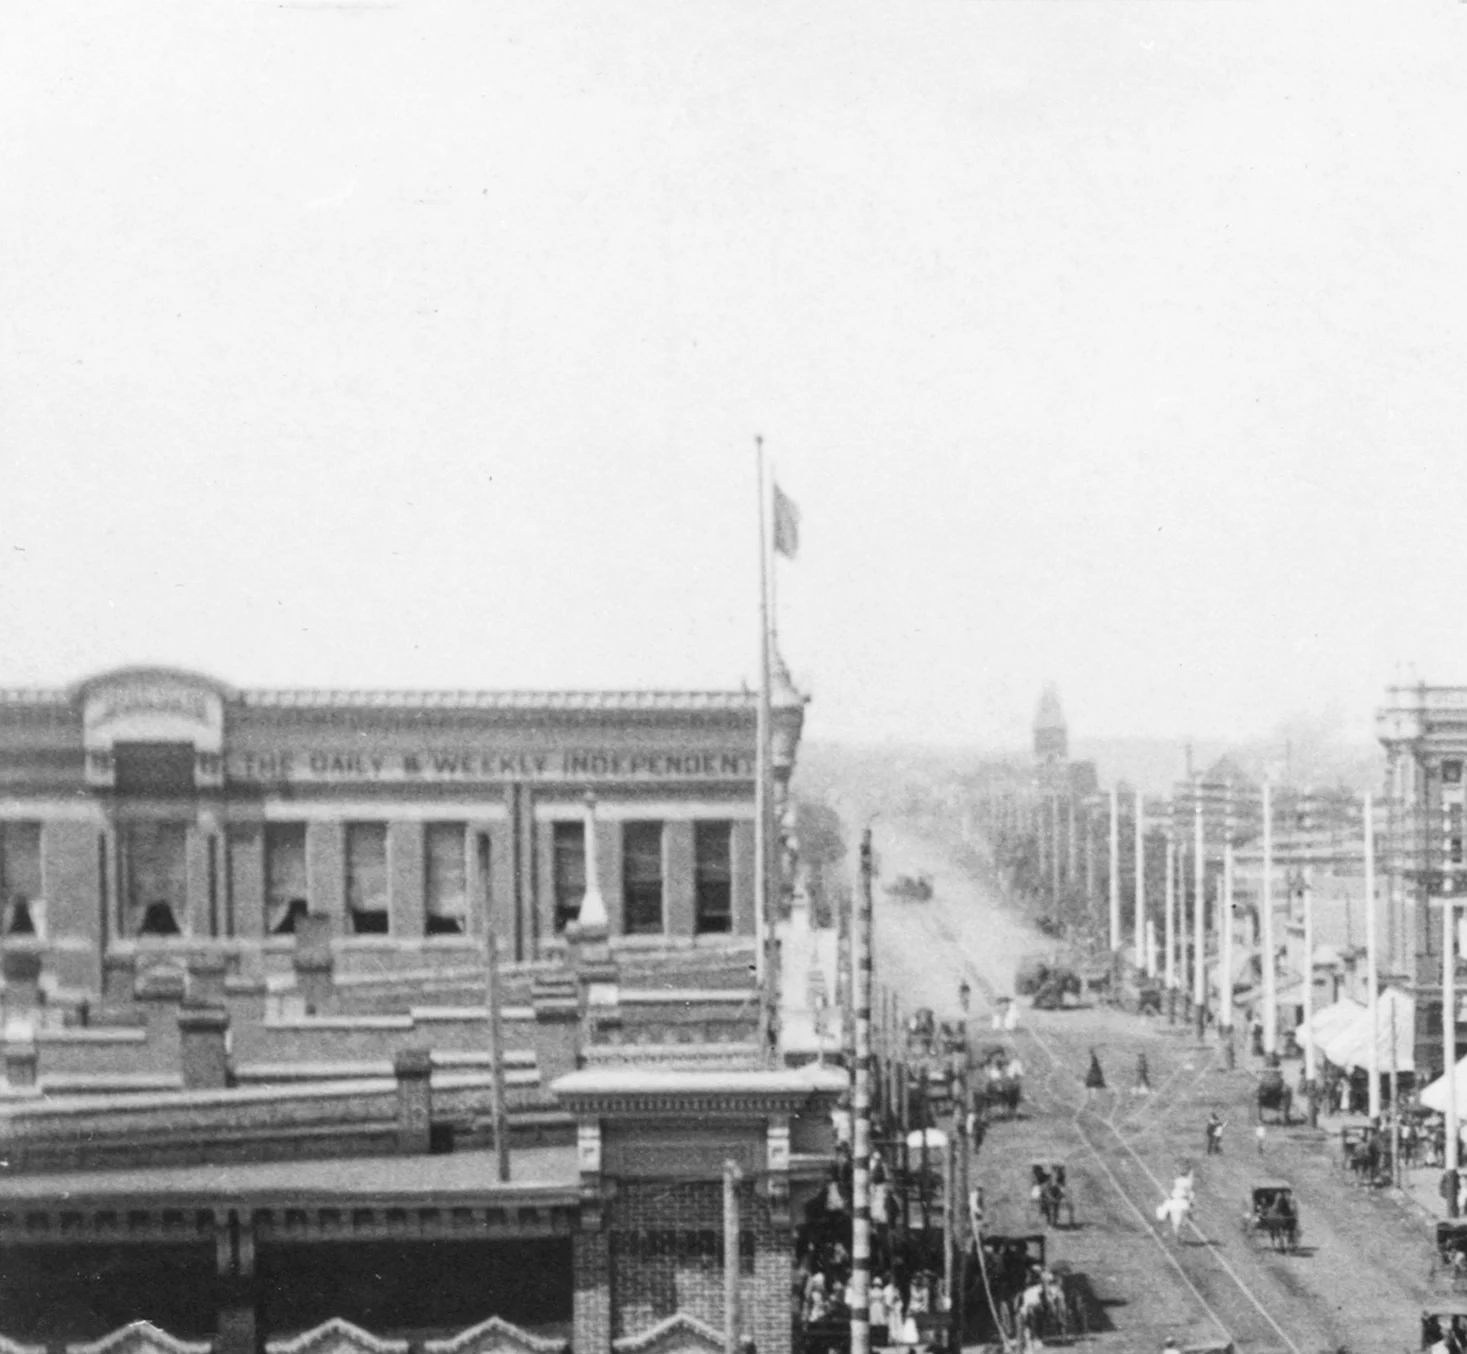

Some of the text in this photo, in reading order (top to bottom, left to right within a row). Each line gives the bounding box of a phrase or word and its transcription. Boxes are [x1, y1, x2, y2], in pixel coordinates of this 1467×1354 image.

[242, 753, 293, 777] THE
[309, 754, 386, 775] DAILY
[432, 754, 547, 776] WEEKLY
